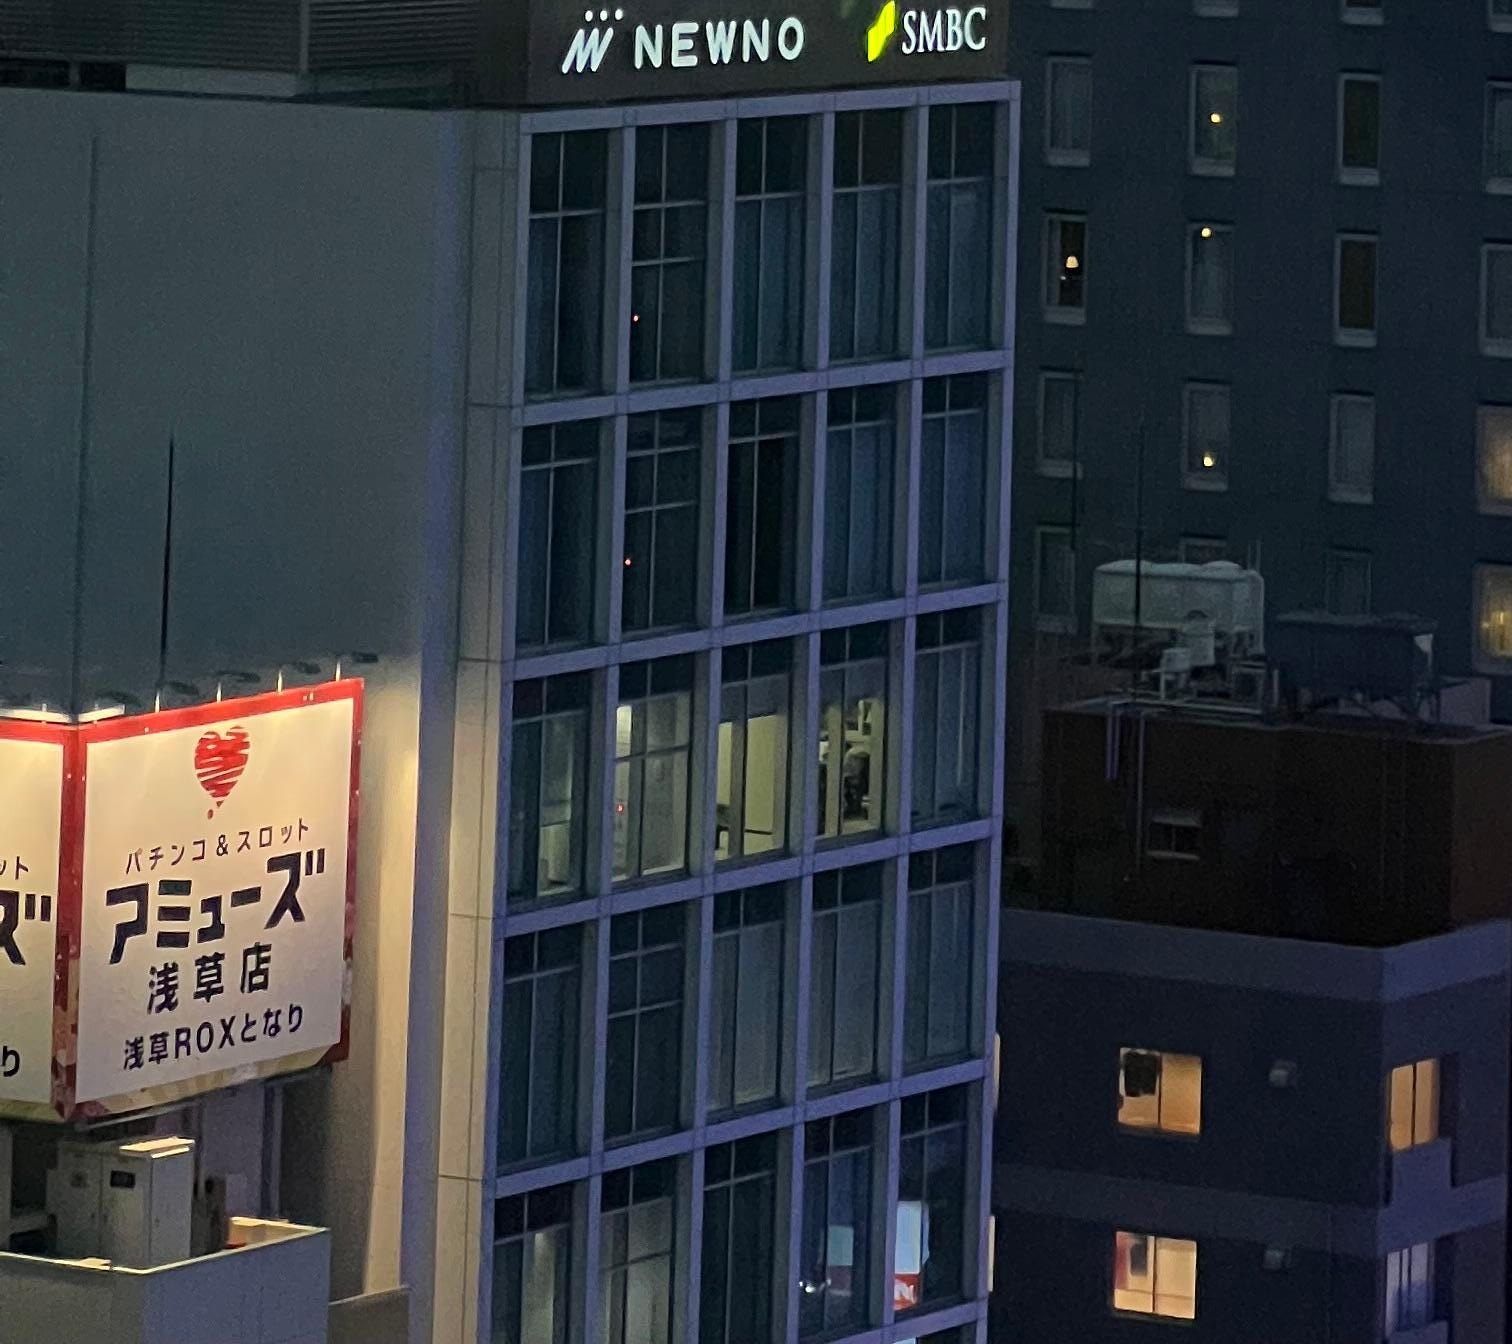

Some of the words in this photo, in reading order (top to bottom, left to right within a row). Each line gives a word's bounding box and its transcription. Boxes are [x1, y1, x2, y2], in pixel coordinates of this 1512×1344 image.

[634, 16, 805, 70] NEWNO
[901, 6, 987, 55] SMBC
[125, 817, 310, 875] パチンコ&スロット
[106, 848, 326, 965] アミューズ
[146, 941, 273, 1015] 浅草店
[122, 1003, 304, 1071] 浅草ROXとなり
